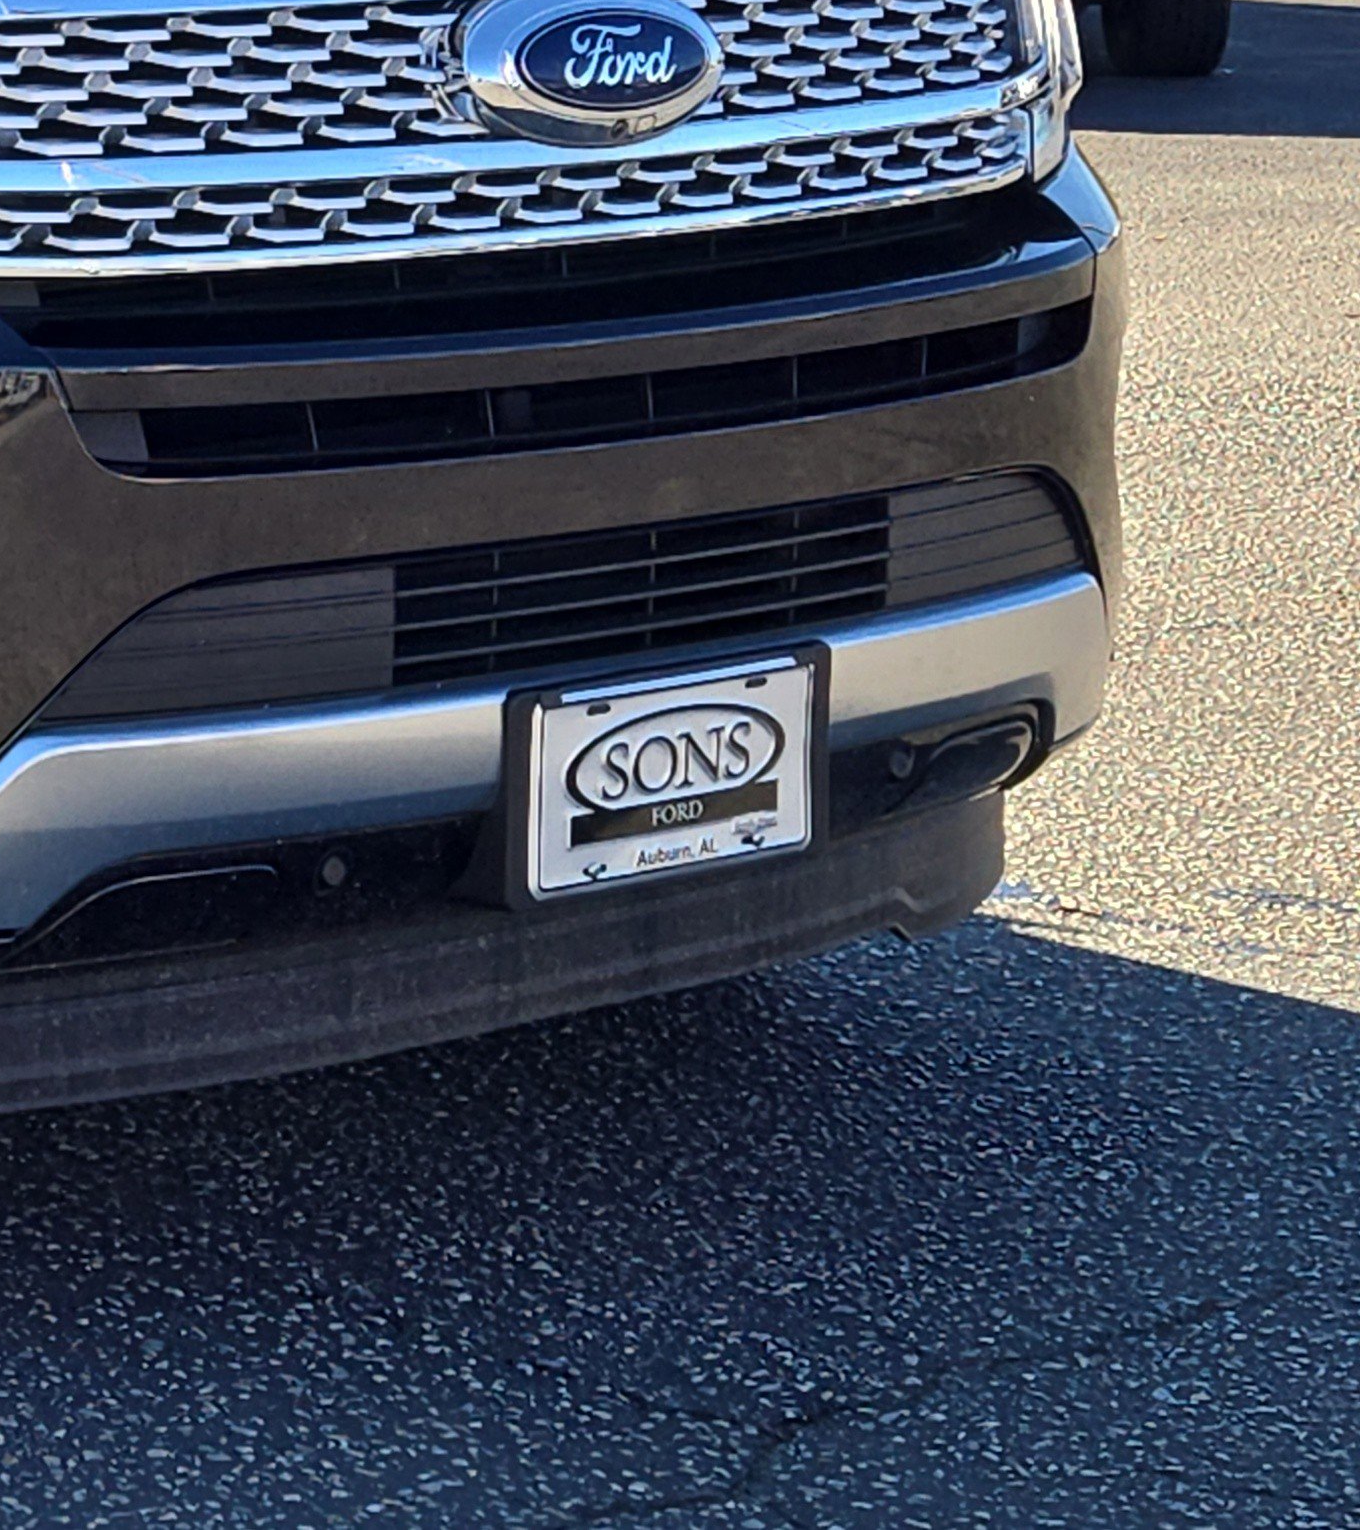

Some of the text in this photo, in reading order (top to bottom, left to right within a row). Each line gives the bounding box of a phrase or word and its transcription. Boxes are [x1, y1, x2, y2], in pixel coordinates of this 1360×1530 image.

[563, 22, 678, 88] Ford
[600, 720, 752, 802] SONS
[651, 799, 704, 827] FORD
[699, 837, 719, 856] AL
